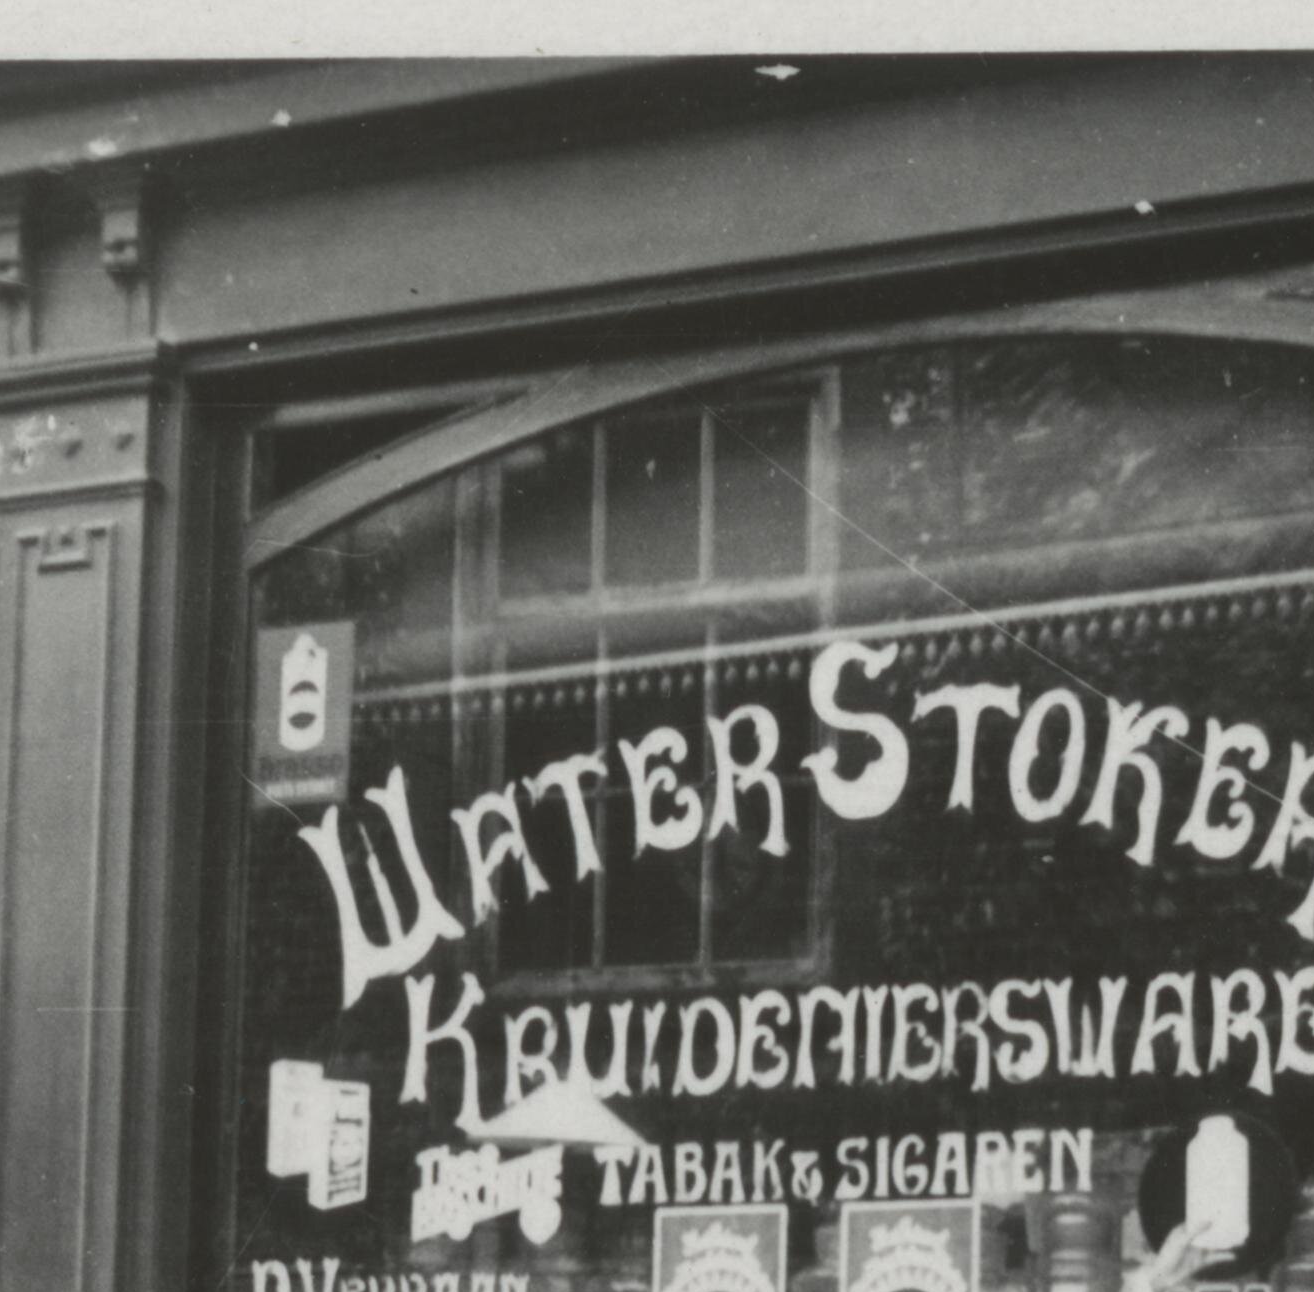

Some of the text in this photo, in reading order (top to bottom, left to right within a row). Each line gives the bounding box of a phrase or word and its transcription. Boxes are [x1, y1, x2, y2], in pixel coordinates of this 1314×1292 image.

[593, 1138, 785, 1206] TABAK
[790, 1150, 825, 1207] &
[834, 1127, 1094, 1201] SIGAREN
